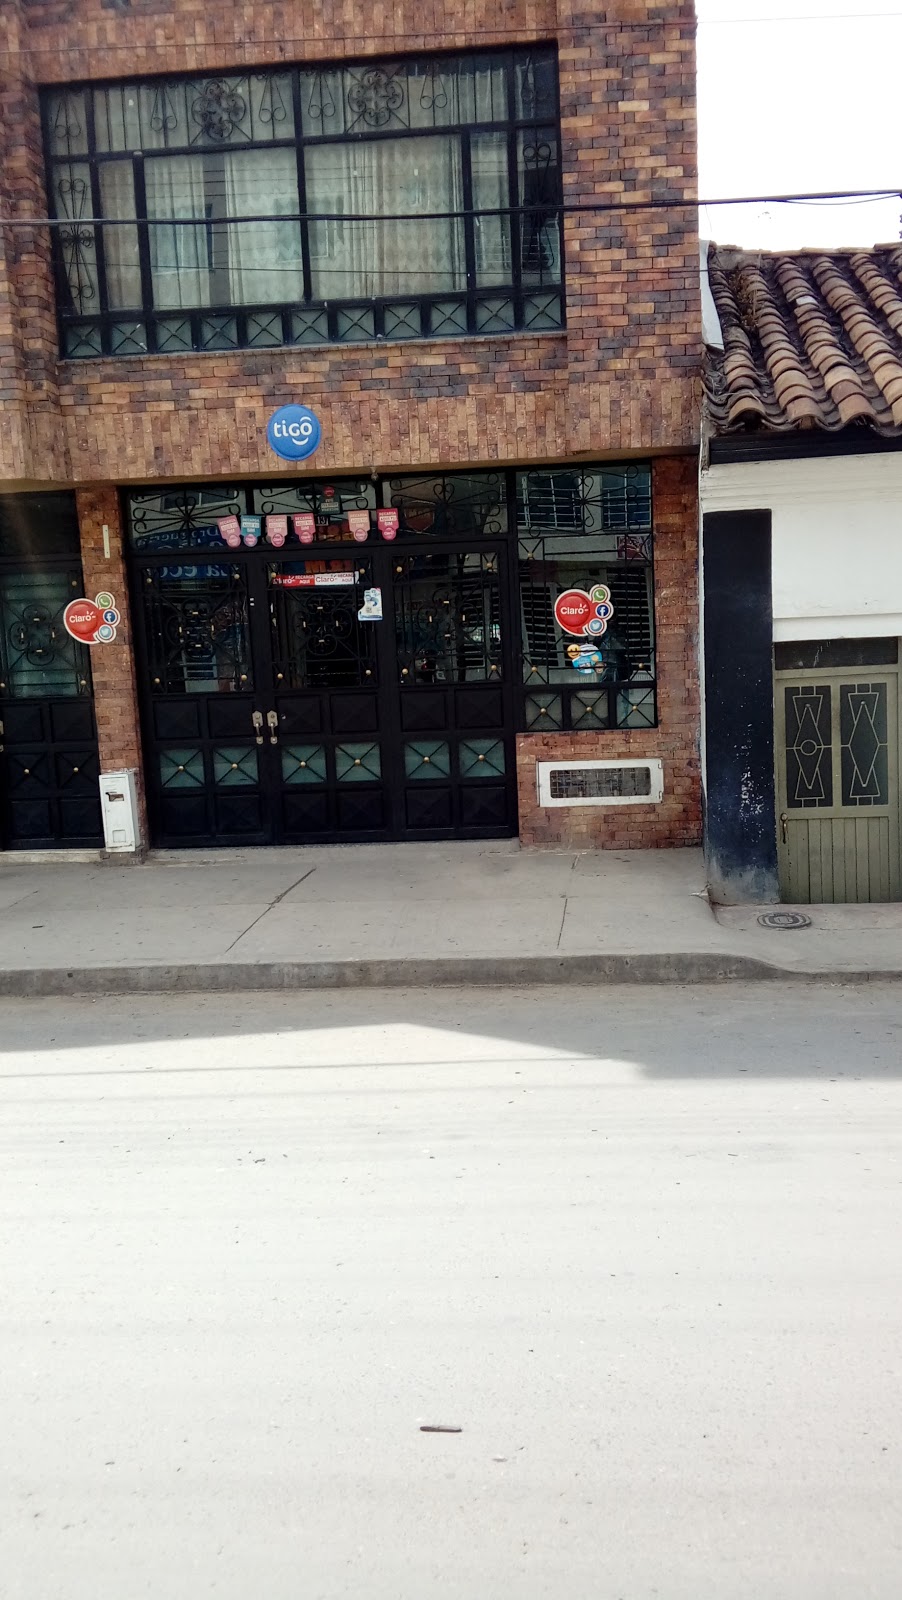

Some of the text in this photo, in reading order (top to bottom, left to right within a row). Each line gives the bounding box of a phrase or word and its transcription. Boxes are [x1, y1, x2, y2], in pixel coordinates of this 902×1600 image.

[273, 417, 313, 440] tigo
[560, 605, 585, 615] Claro
[69, 613, 93, 624] Claro
